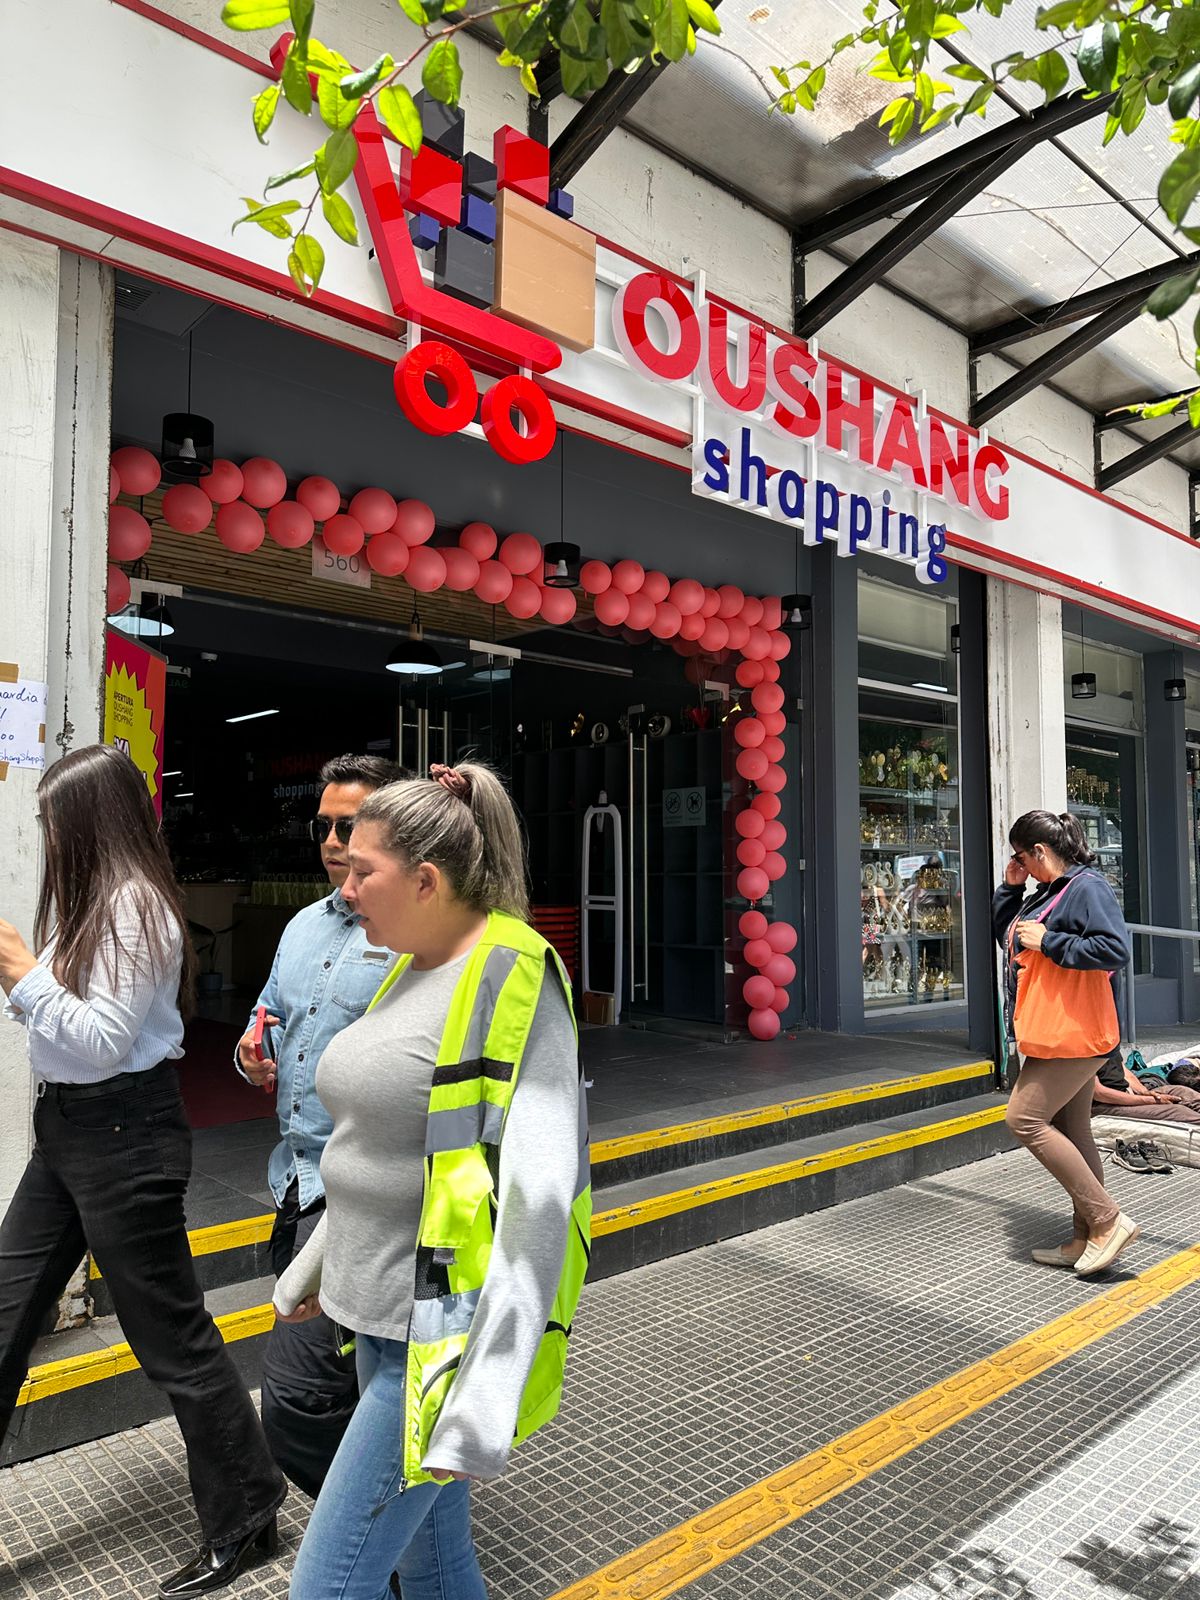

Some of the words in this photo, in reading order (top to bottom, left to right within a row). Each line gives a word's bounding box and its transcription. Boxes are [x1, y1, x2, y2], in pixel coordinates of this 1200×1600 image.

[614, 272, 1010, 522] OUSHANG
[700, 427, 948, 584] shopping
[324, 549, 360, 574] 560
[273, 781, 322, 800] shopping
